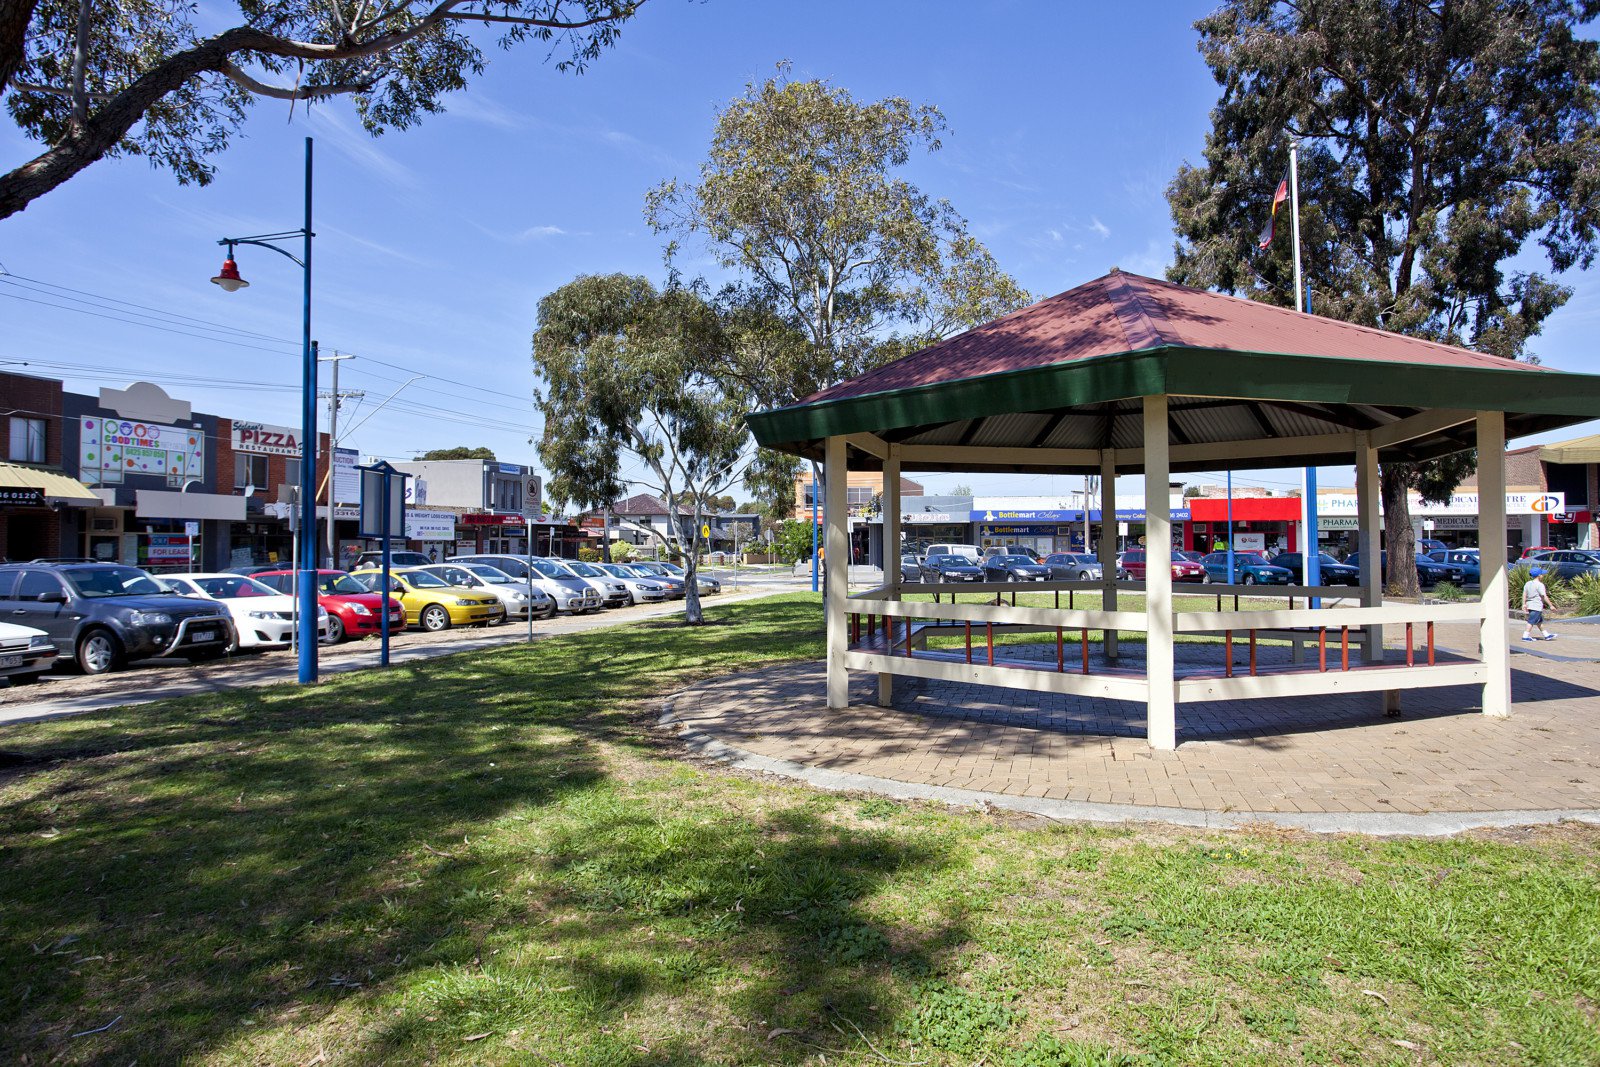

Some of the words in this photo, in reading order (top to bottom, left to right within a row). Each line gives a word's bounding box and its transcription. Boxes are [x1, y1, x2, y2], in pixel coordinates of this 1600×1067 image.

[104, 434, 160, 448] GOODTIMES
[241, 429, 297, 449] PIZZA
[240, 444, 297, 454] RESTAURANT
[998, 511, 1036, 519] Bottlemart
[1436, 517, 1470, 525] MEDICAL
